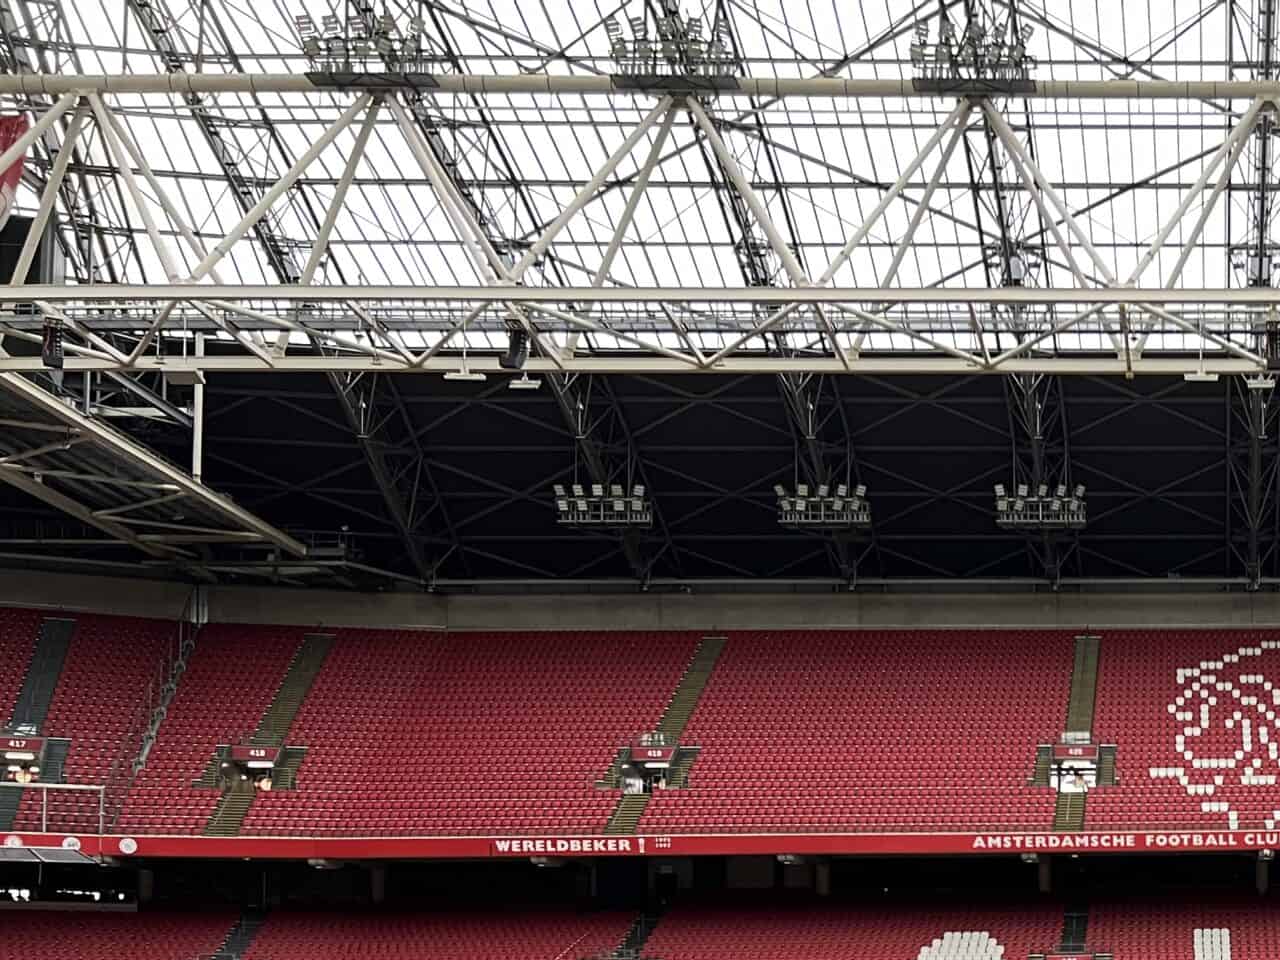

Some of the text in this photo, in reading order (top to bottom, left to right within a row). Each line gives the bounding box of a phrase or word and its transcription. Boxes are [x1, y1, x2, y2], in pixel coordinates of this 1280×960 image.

[495, 839, 631, 852] WERELDBEKER
[972, 835, 1135, 848] AMSTERDAMSCHE
[1145, 834, 1238, 846] FOOTBALL
